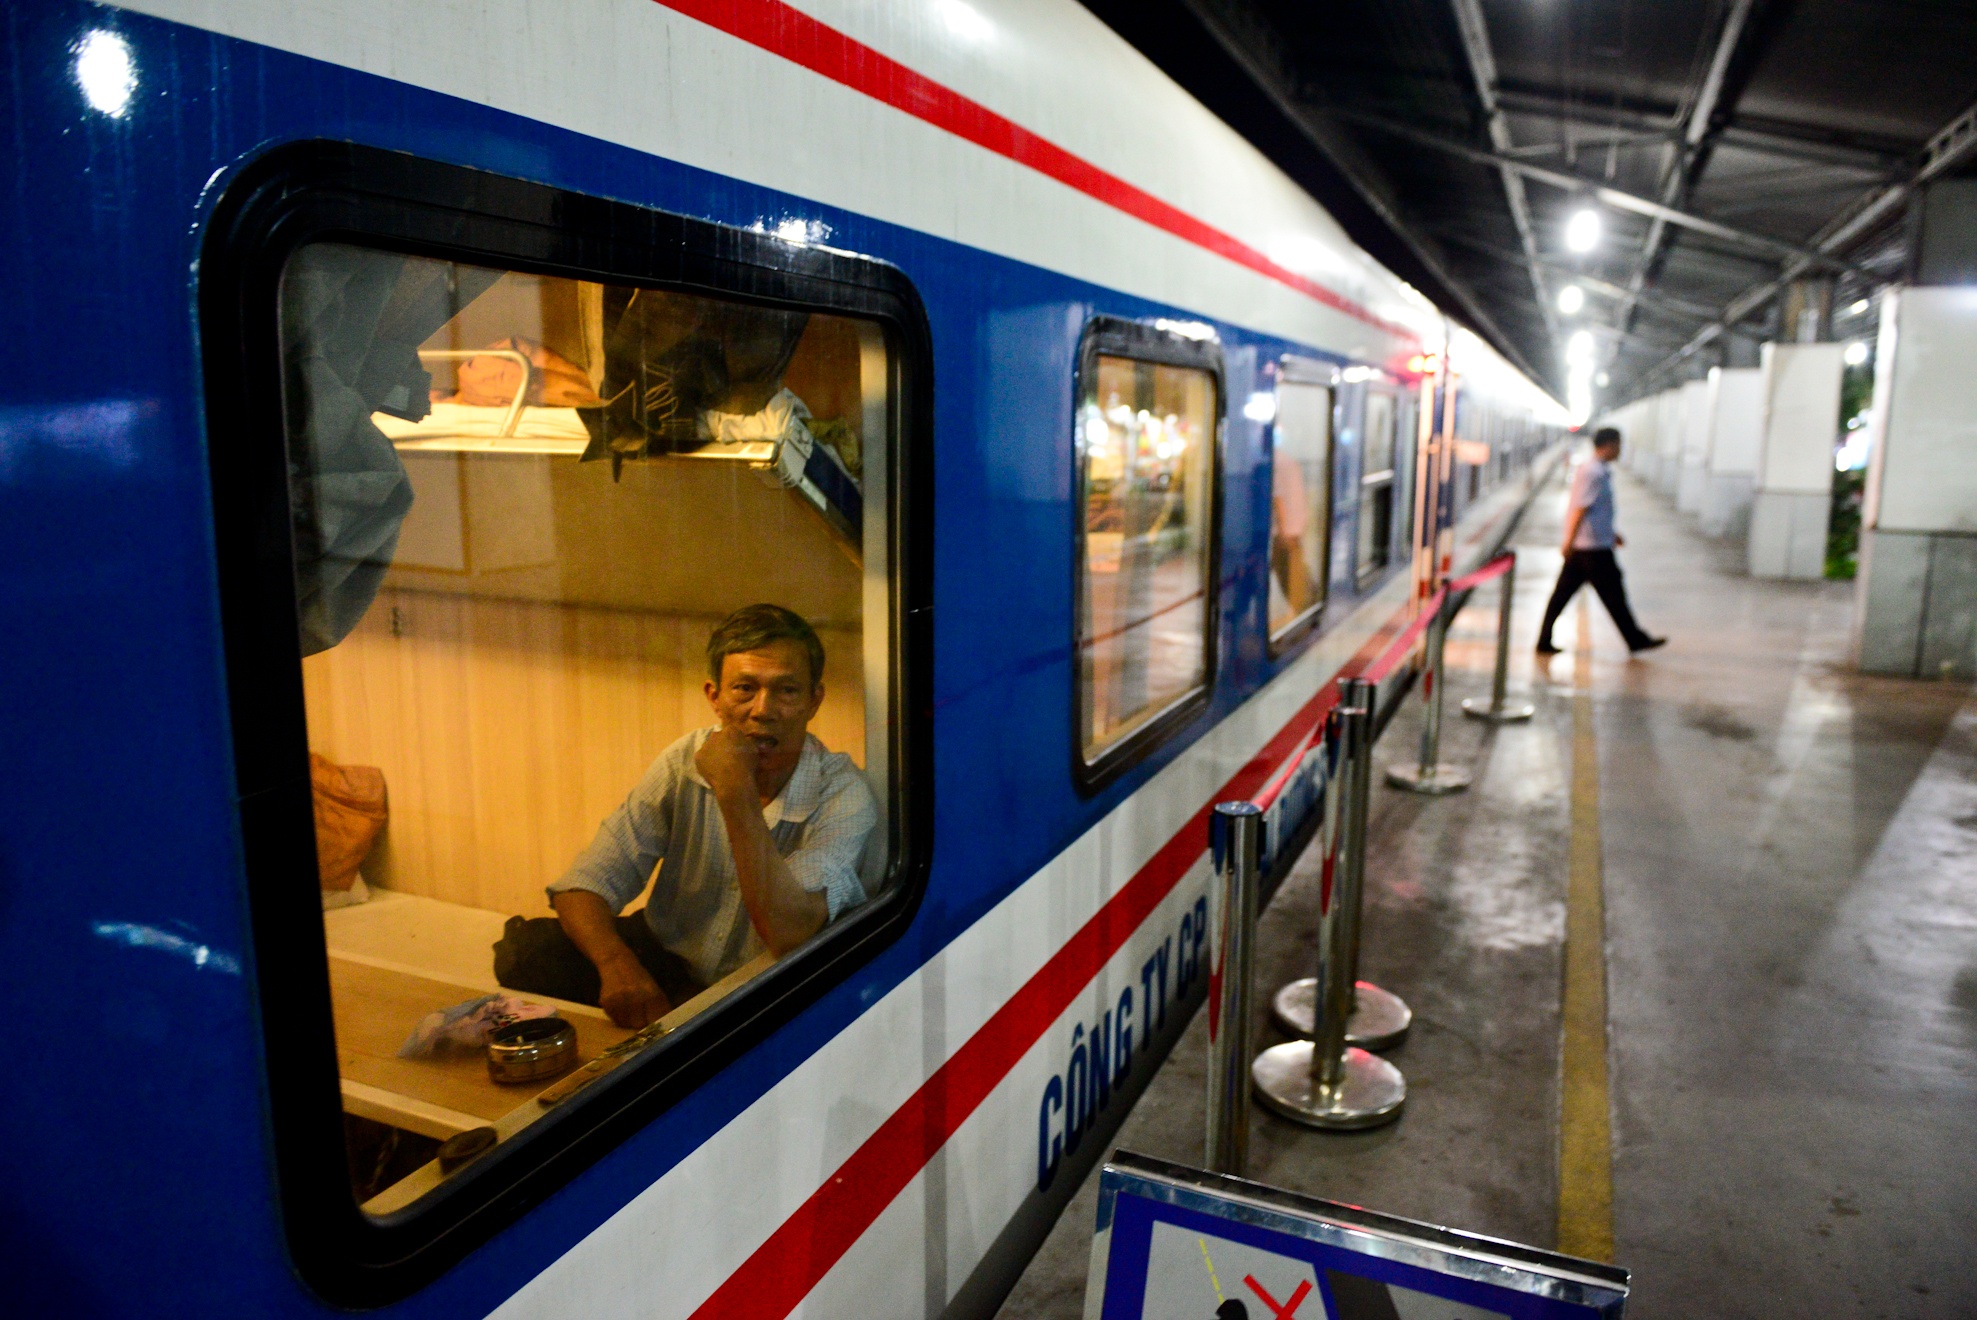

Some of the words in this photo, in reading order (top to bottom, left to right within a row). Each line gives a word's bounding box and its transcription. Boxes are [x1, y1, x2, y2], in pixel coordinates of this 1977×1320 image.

[1038, 986, 1133, 1193] CÔNG
[1142, 935, 1172, 1052] TY
[1177, 895, 1207, 1001] CP
